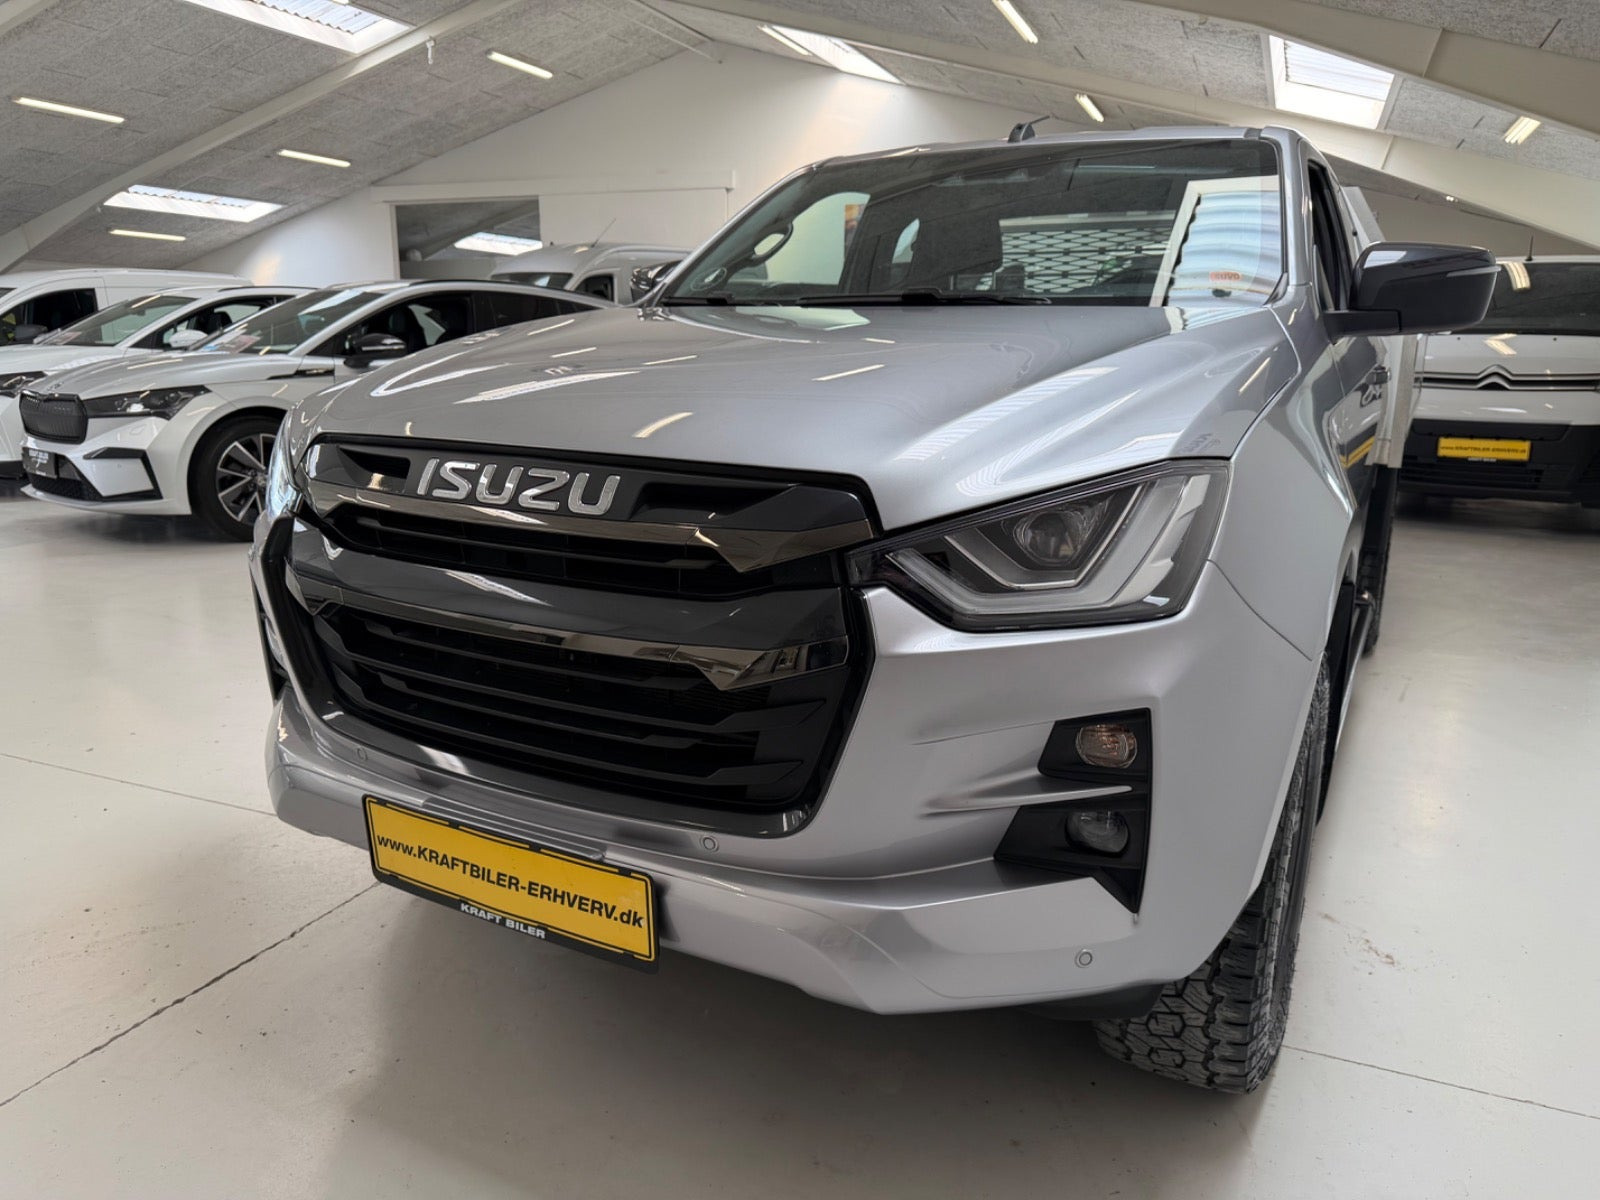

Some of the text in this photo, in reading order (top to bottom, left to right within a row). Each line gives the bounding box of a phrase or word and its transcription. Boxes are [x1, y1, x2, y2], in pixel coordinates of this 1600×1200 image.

[416, 458, 621, 515] ISUZU
[376, 834, 645, 929] www.KRAFTBILER-ERHVERV.dk
[460, 902, 546, 940] KRAFT BILER
